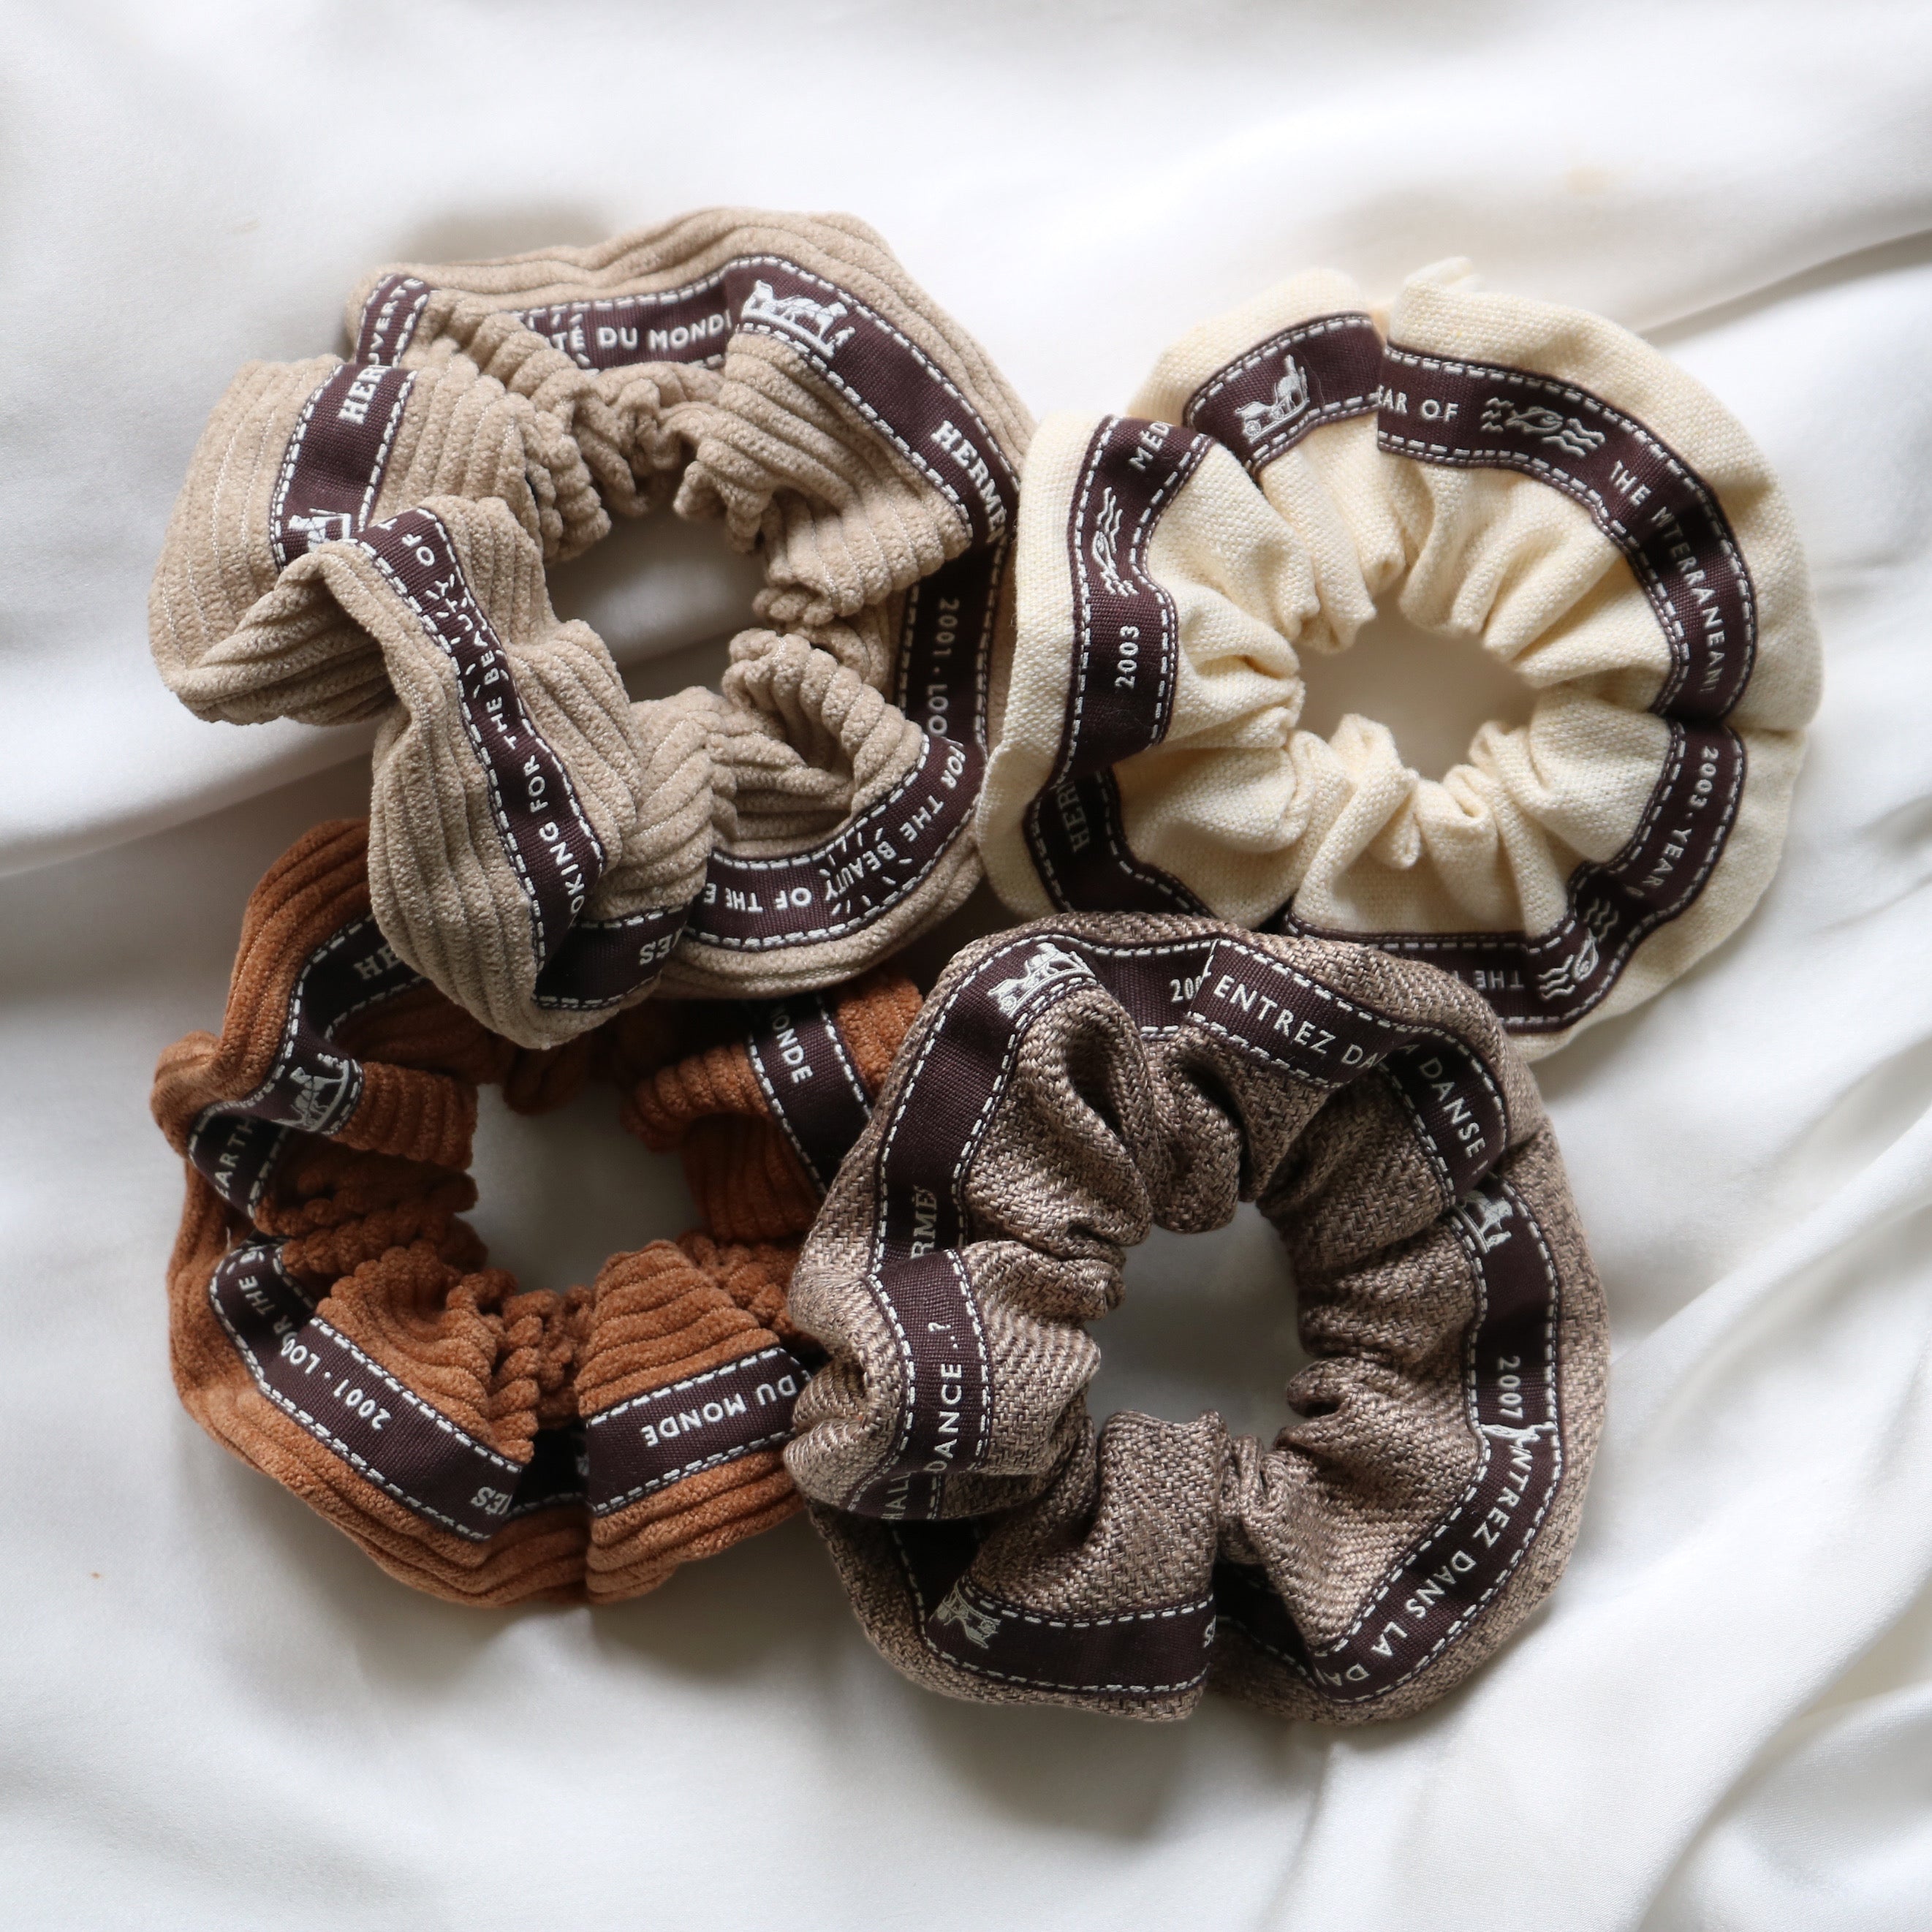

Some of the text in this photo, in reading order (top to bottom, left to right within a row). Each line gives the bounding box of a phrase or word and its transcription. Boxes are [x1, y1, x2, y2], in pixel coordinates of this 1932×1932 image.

[596, 327, 637, 349] DU
[648, 308, 732, 350] MOND
[338, 365, 393, 425] HER
[1420, 398, 1459, 422] OF
[1129, 421, 1175, 469] MÉD
[1608, 460, 1652, 507] THE
[402, 533, 435, 567] OF
[1115, 624, 1140, 690] 2003
[486, 696, 517, 750] THE
[523, 754, 548, 813] FOR
[898, 795, 944, 842] THE
[824, 841, 896, 902] BEAUTY
[1642, 828, 1692, 886] YEAR
[724, 892, 763, 914] THE
[775, 887, 813, 911] OF
[1474, 969, 1525, 989] THE
[770, 1004, 814, 1083] ONDE
[1213, 974, 1337, 1055] ENTREZ
[1341, 1042, 1387, 1068] DA
[238, 1276, 276, 1315] THE
[640, 1374, 798, 1447] DU MONDE
[1498, 1355, 1524, 1420] 2007
[923, 1363, 963, 1472] DANCE
[1472, 1444, 1533, 1547] NTREZ
[1404, 1550, 1477, 1618] DANS
[1371, 1621, 1408, 1656] LA
